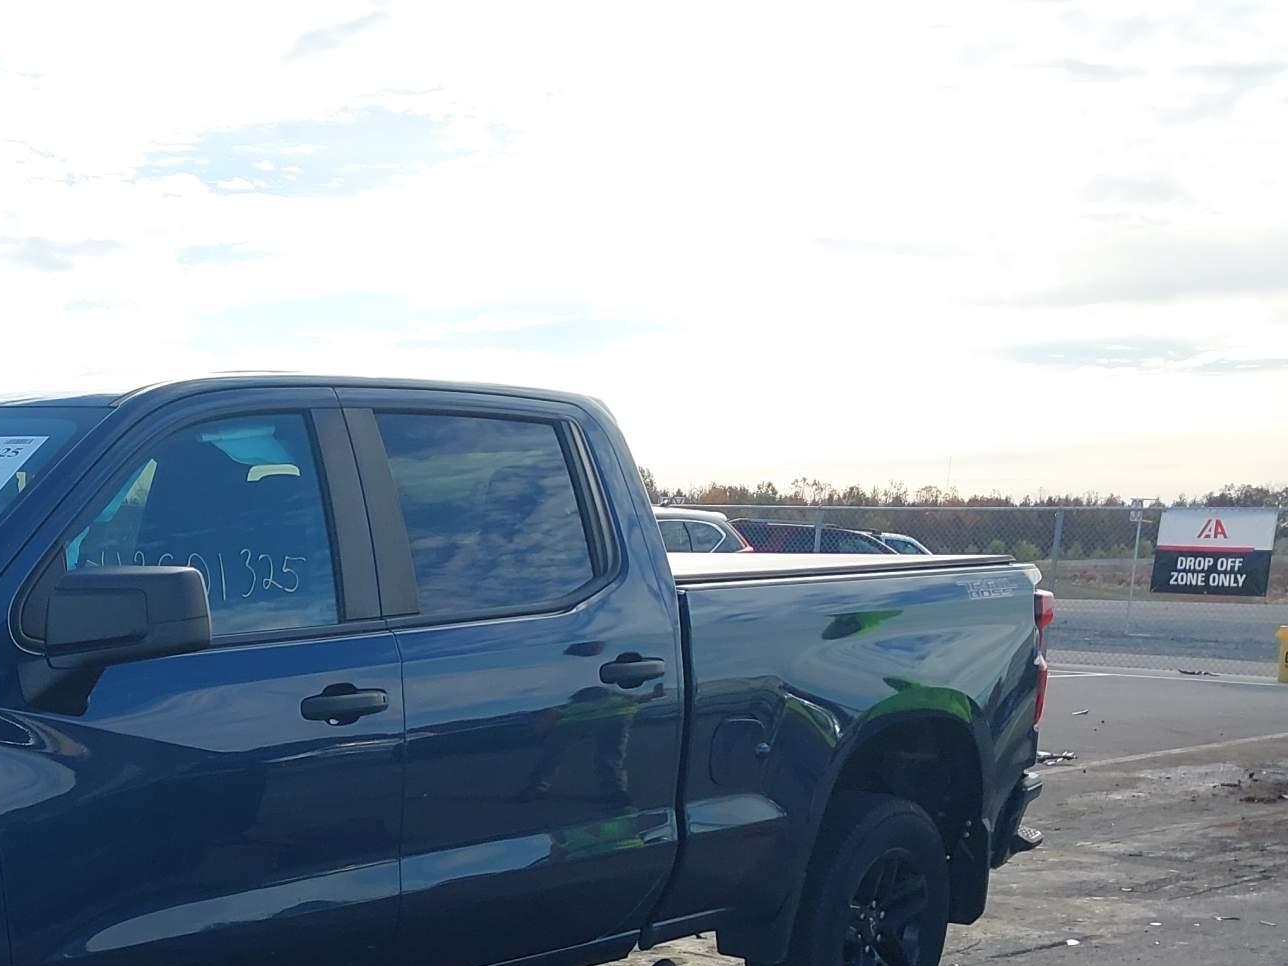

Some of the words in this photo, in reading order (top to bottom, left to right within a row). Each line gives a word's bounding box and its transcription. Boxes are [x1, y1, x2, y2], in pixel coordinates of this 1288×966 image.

[1177, 557, 1213, 571] DROP
[1217, 557, 1244, 572] OFF
[100, 549, 306, 600] 01325
[1170, 572, 1206, 586] ZONE
[1209, 573, 1247, 588] ONLY
